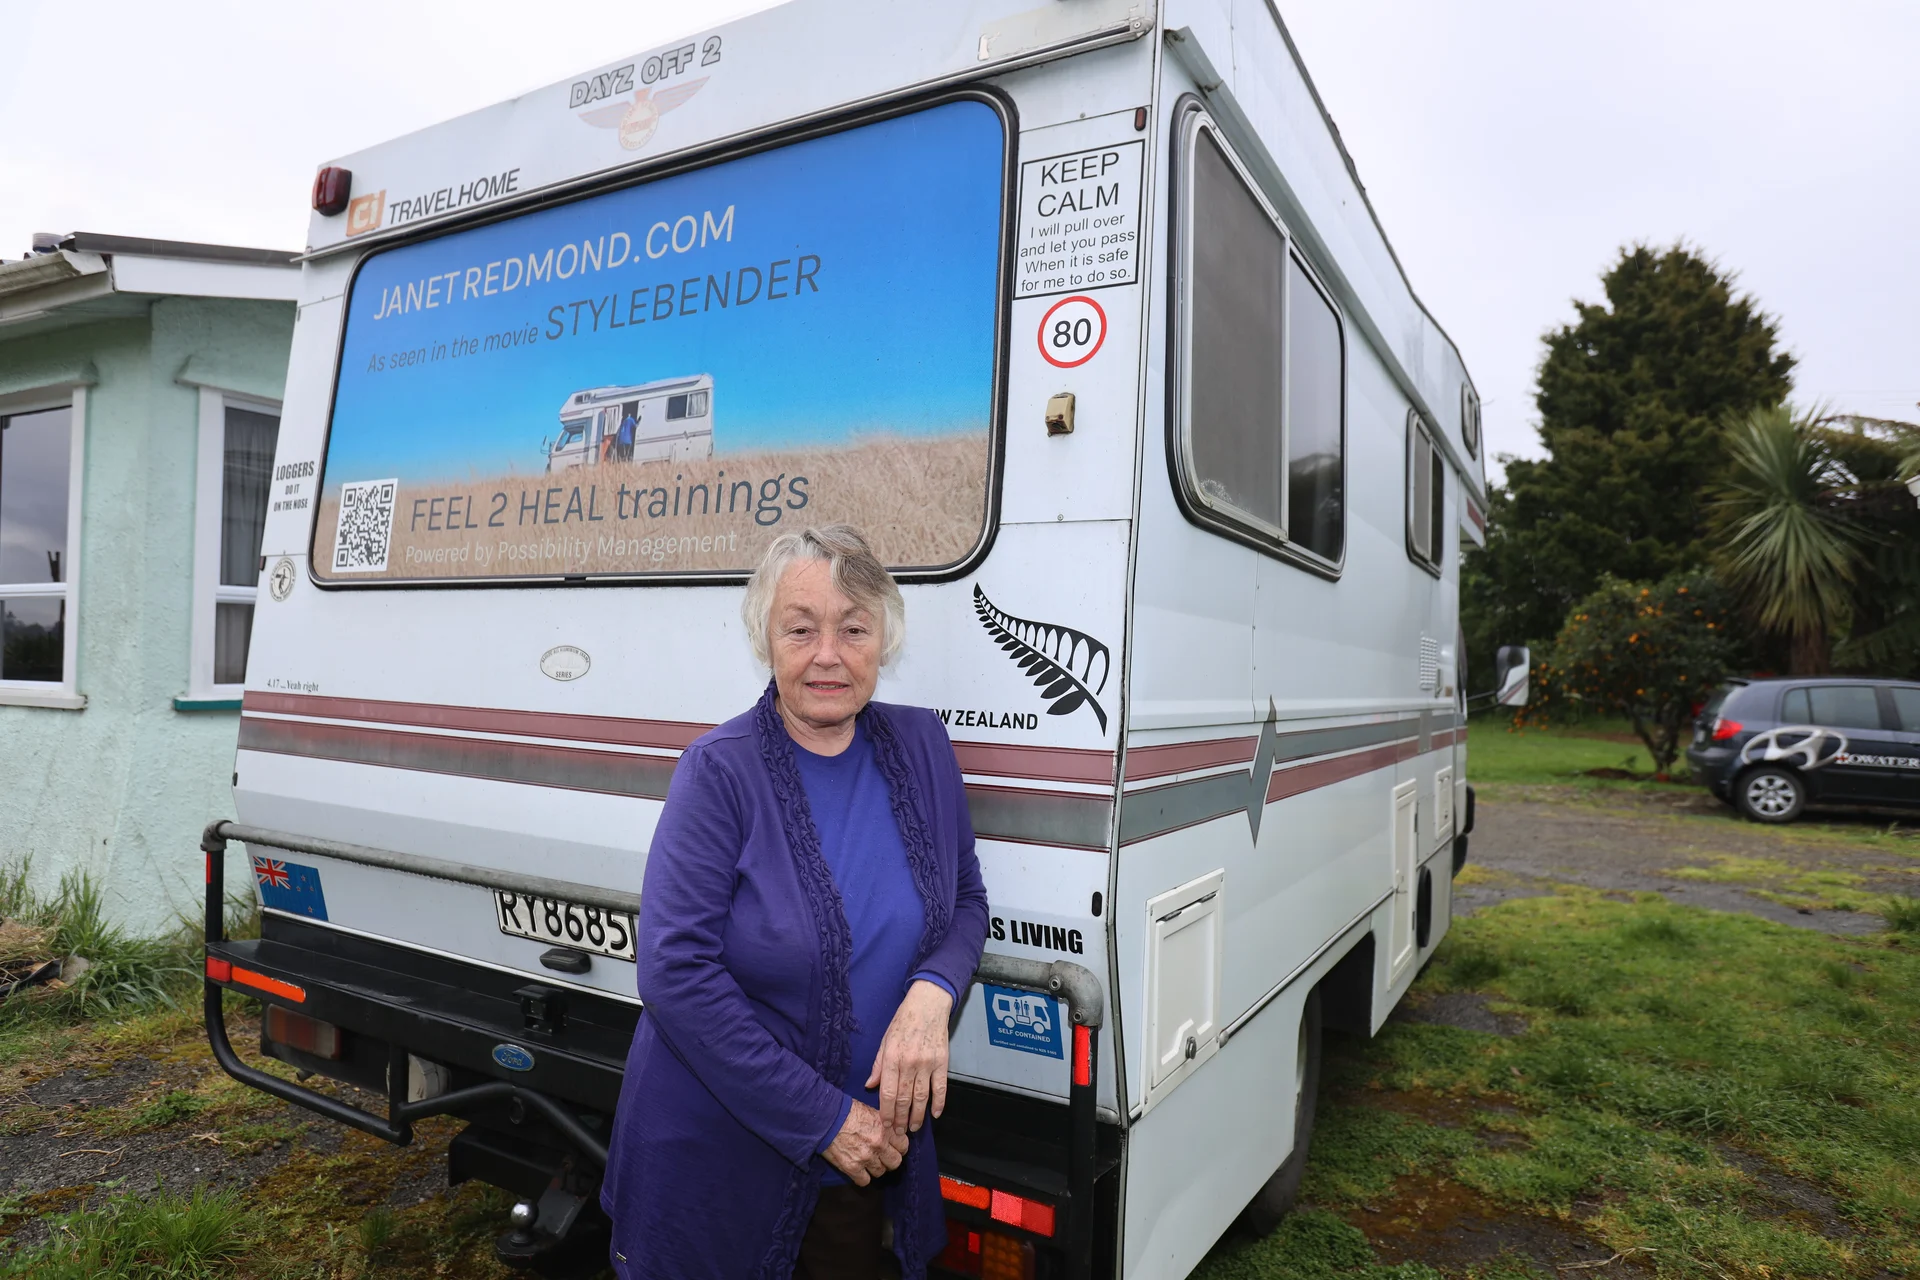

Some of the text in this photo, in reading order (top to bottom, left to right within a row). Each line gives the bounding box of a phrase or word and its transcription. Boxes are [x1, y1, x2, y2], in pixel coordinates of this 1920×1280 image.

[569, 36, 722, 109] DAYZ OFF 2
[1040, 152, 1120, 187] KEEP
[389, 168, 520, 225] TRAVELHOME
[1037, 182, 1119, 217] CALM
[1030, 213, 1125, 239] I will pull over
[1020, 230, 1135, 257] and let you pass
[373, 205, 735, 320] JANETREDMOND.COM
[1025, 247, 1129, 274] When it is safe
[1021, 268, 1130, 292] for me to do so.
[366, 254, 822, 374] As seen in the movie STYLEBENDER
[1052, 317, 1092, 348] 80
[276, 460, 315, 481] LOGGERS
[273, 498, 308, 512] ON THE NOSE
[285, 484, 300, 495] DO IT
[410, 470, 810, 532] FEEL 2 HEAL trainings
[405, 528, 737, 564] Powered by Possibility Management
[954, 709, 1038, 730] ZEALAND
[500, 890, 628, 950] RY8685
[1010, 920, 1083, 955] LIVING
[998, 1027, 1051, 1043] SELF CONTAINED
[501, 1049, 525, 1066] Ford
